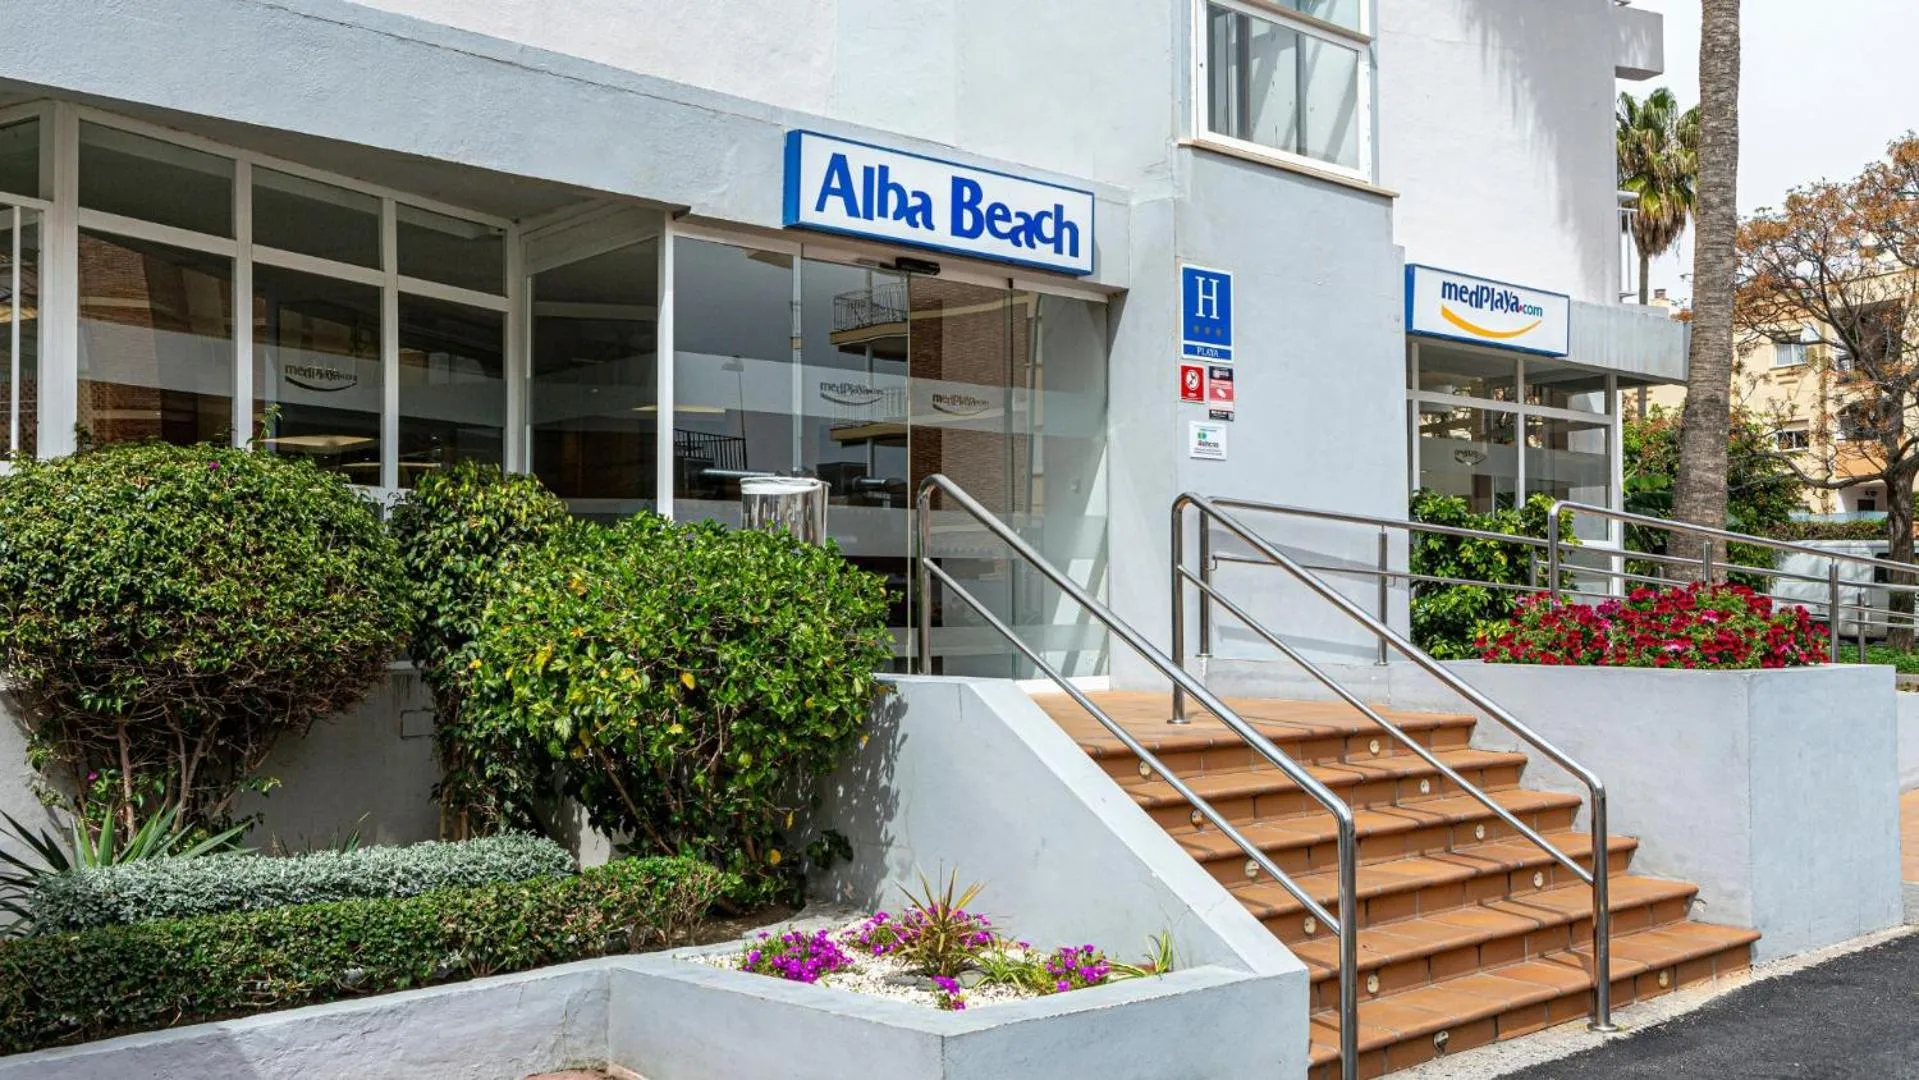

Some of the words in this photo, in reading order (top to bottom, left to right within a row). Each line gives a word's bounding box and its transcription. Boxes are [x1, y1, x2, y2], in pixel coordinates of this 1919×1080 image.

[815, 152, 935, 231] Alba
[951, 175, 1080, 258] Beach
[1196, 277, 1220, 320] H
[1197, 346, 1220, 358] PLAYA
